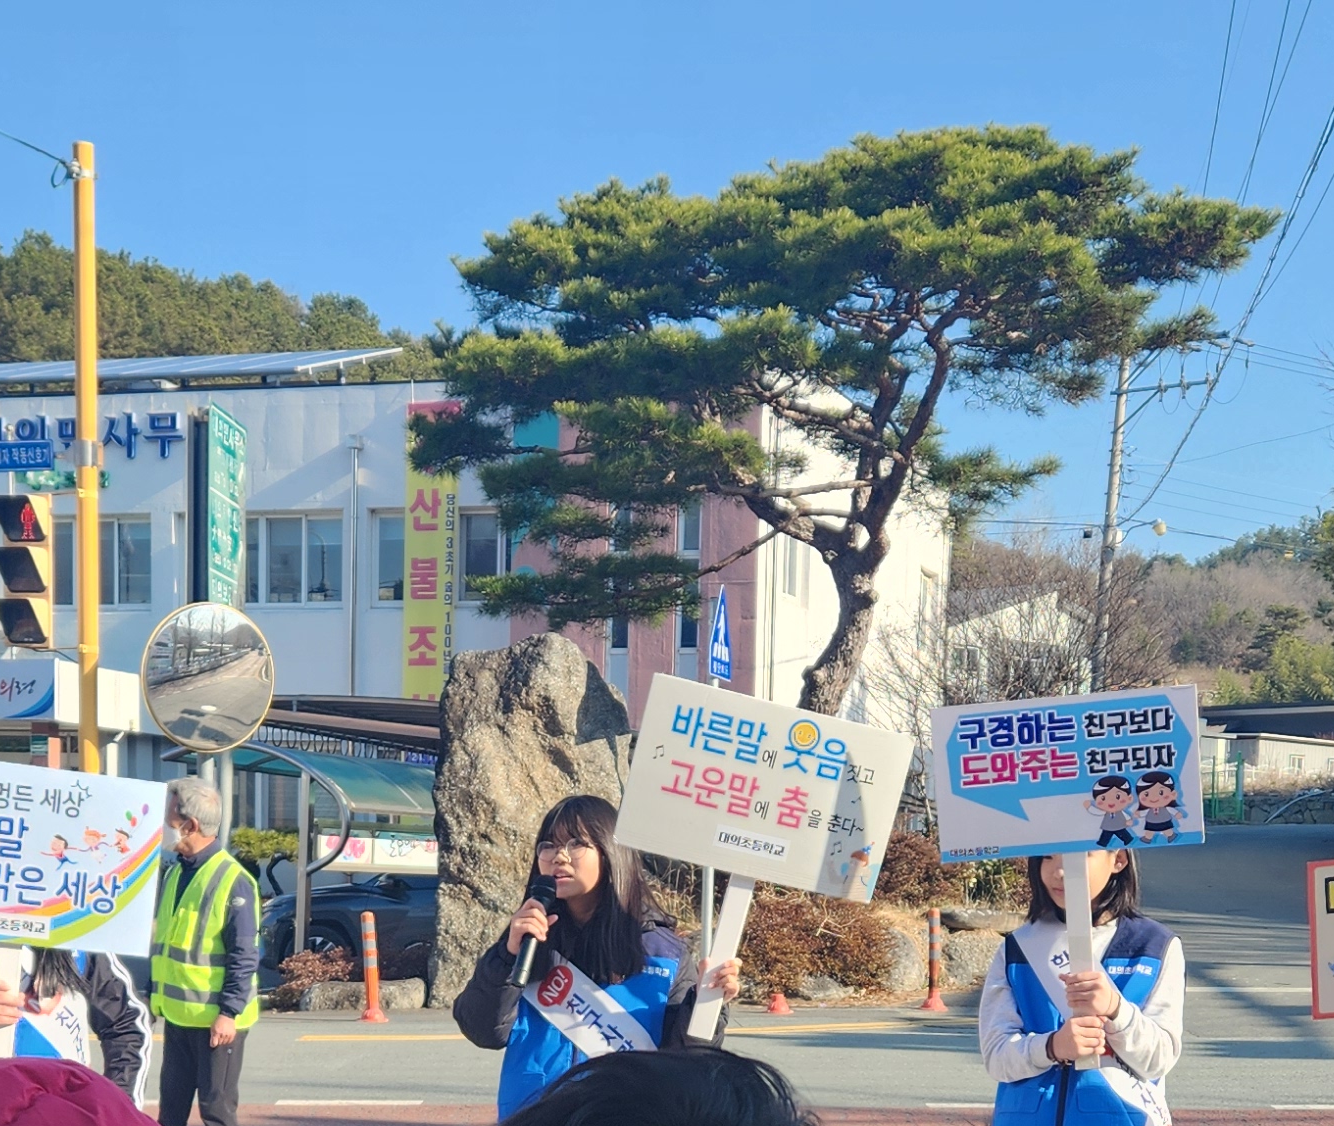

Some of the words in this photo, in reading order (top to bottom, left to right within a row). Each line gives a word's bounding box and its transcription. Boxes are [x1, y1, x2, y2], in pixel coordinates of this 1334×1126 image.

[408, 488, 442, 700] 산불조
[671, 704, 778, 769] 바른말에
[959, 711, 1076, 750] 구경하는
[1084, 707, 1173, 738] 친구보다
[961, 747, 1078, 787] 도와주는
[1085, 744, 1176, 774] 친구되자
[40, 788, 85, 818] 세상
[661, 759, 770, 819] 고운말에
[776, 786, 822, 829] 춤을
[718, 831, 785, 857] 대의초등학교
[949, 846, 999, 858] 대의초등학교
[55, 871, 121, 914] 세상
[541, 969, 571, 1003] NO!
[1108, 963, 1152, 975] 대의초학교
